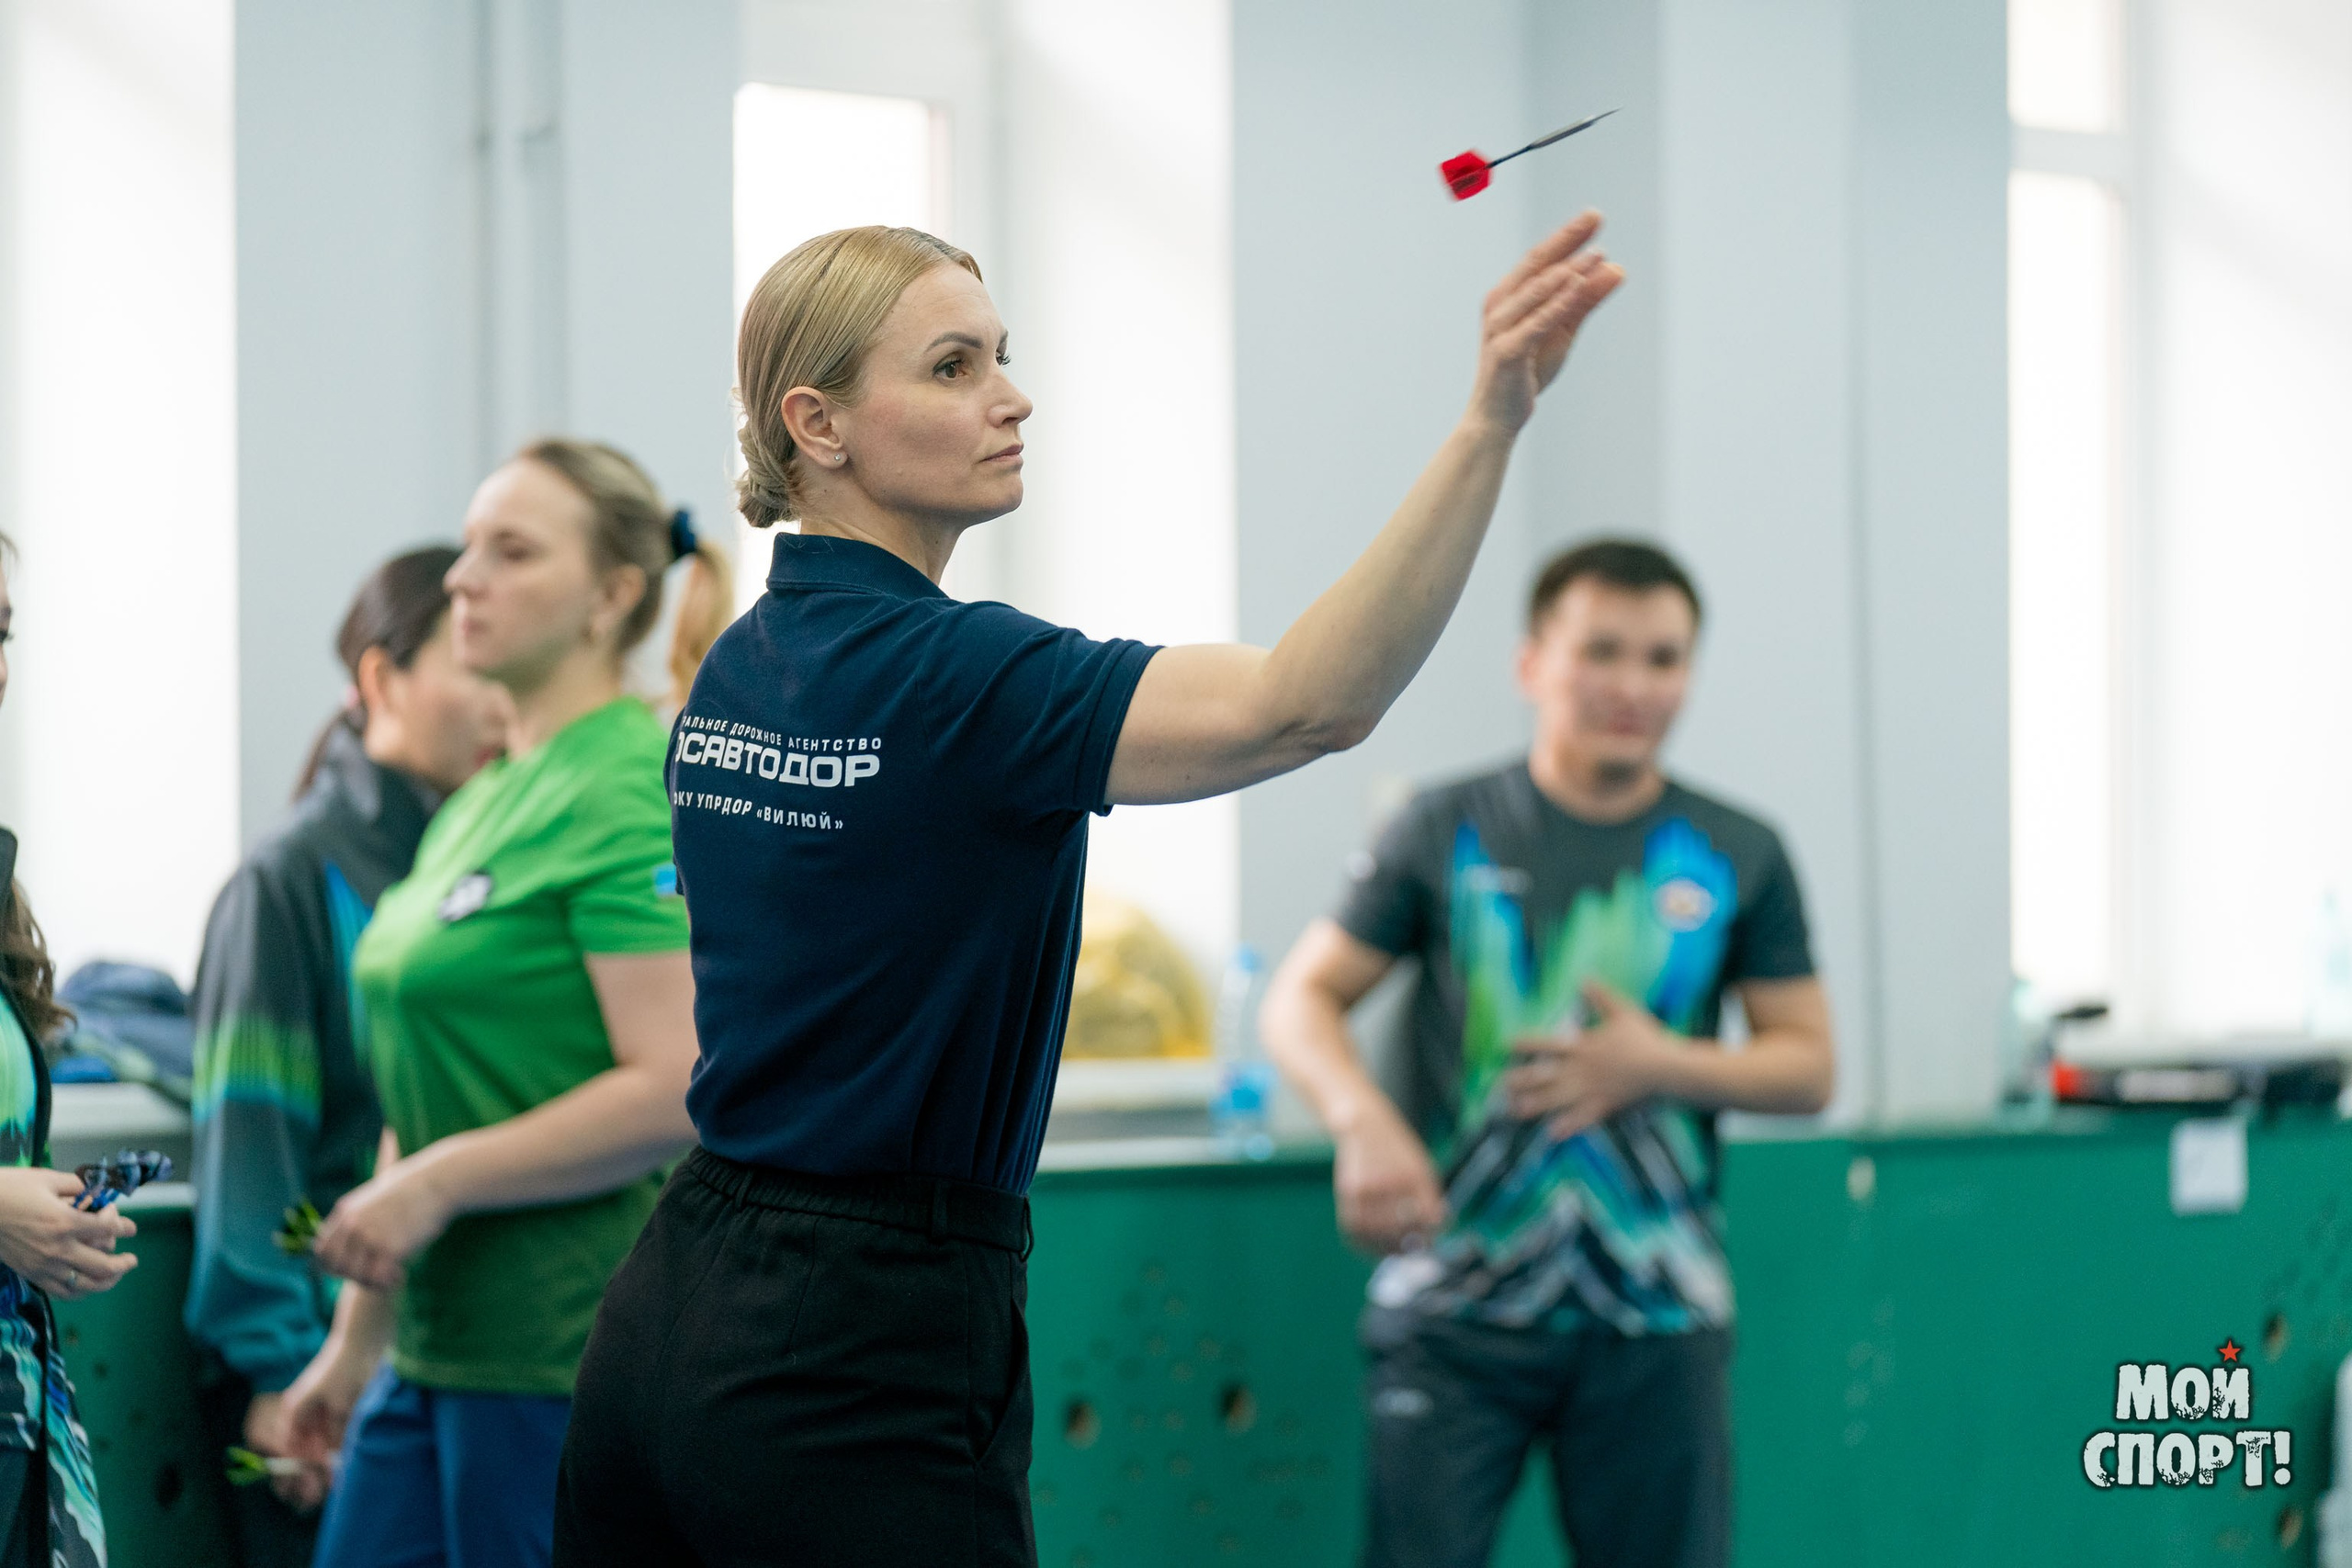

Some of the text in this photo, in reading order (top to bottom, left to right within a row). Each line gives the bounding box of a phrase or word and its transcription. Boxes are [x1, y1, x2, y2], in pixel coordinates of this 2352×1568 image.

[729, 722, 781, 746] ДОРОЖНОЕ
[788, 737, 882, 751] АГЕНТСТВО
[696, 793, 752, 816] УПРДОР
[756, 807, 843, 829] «ВИЛЮЙ»
